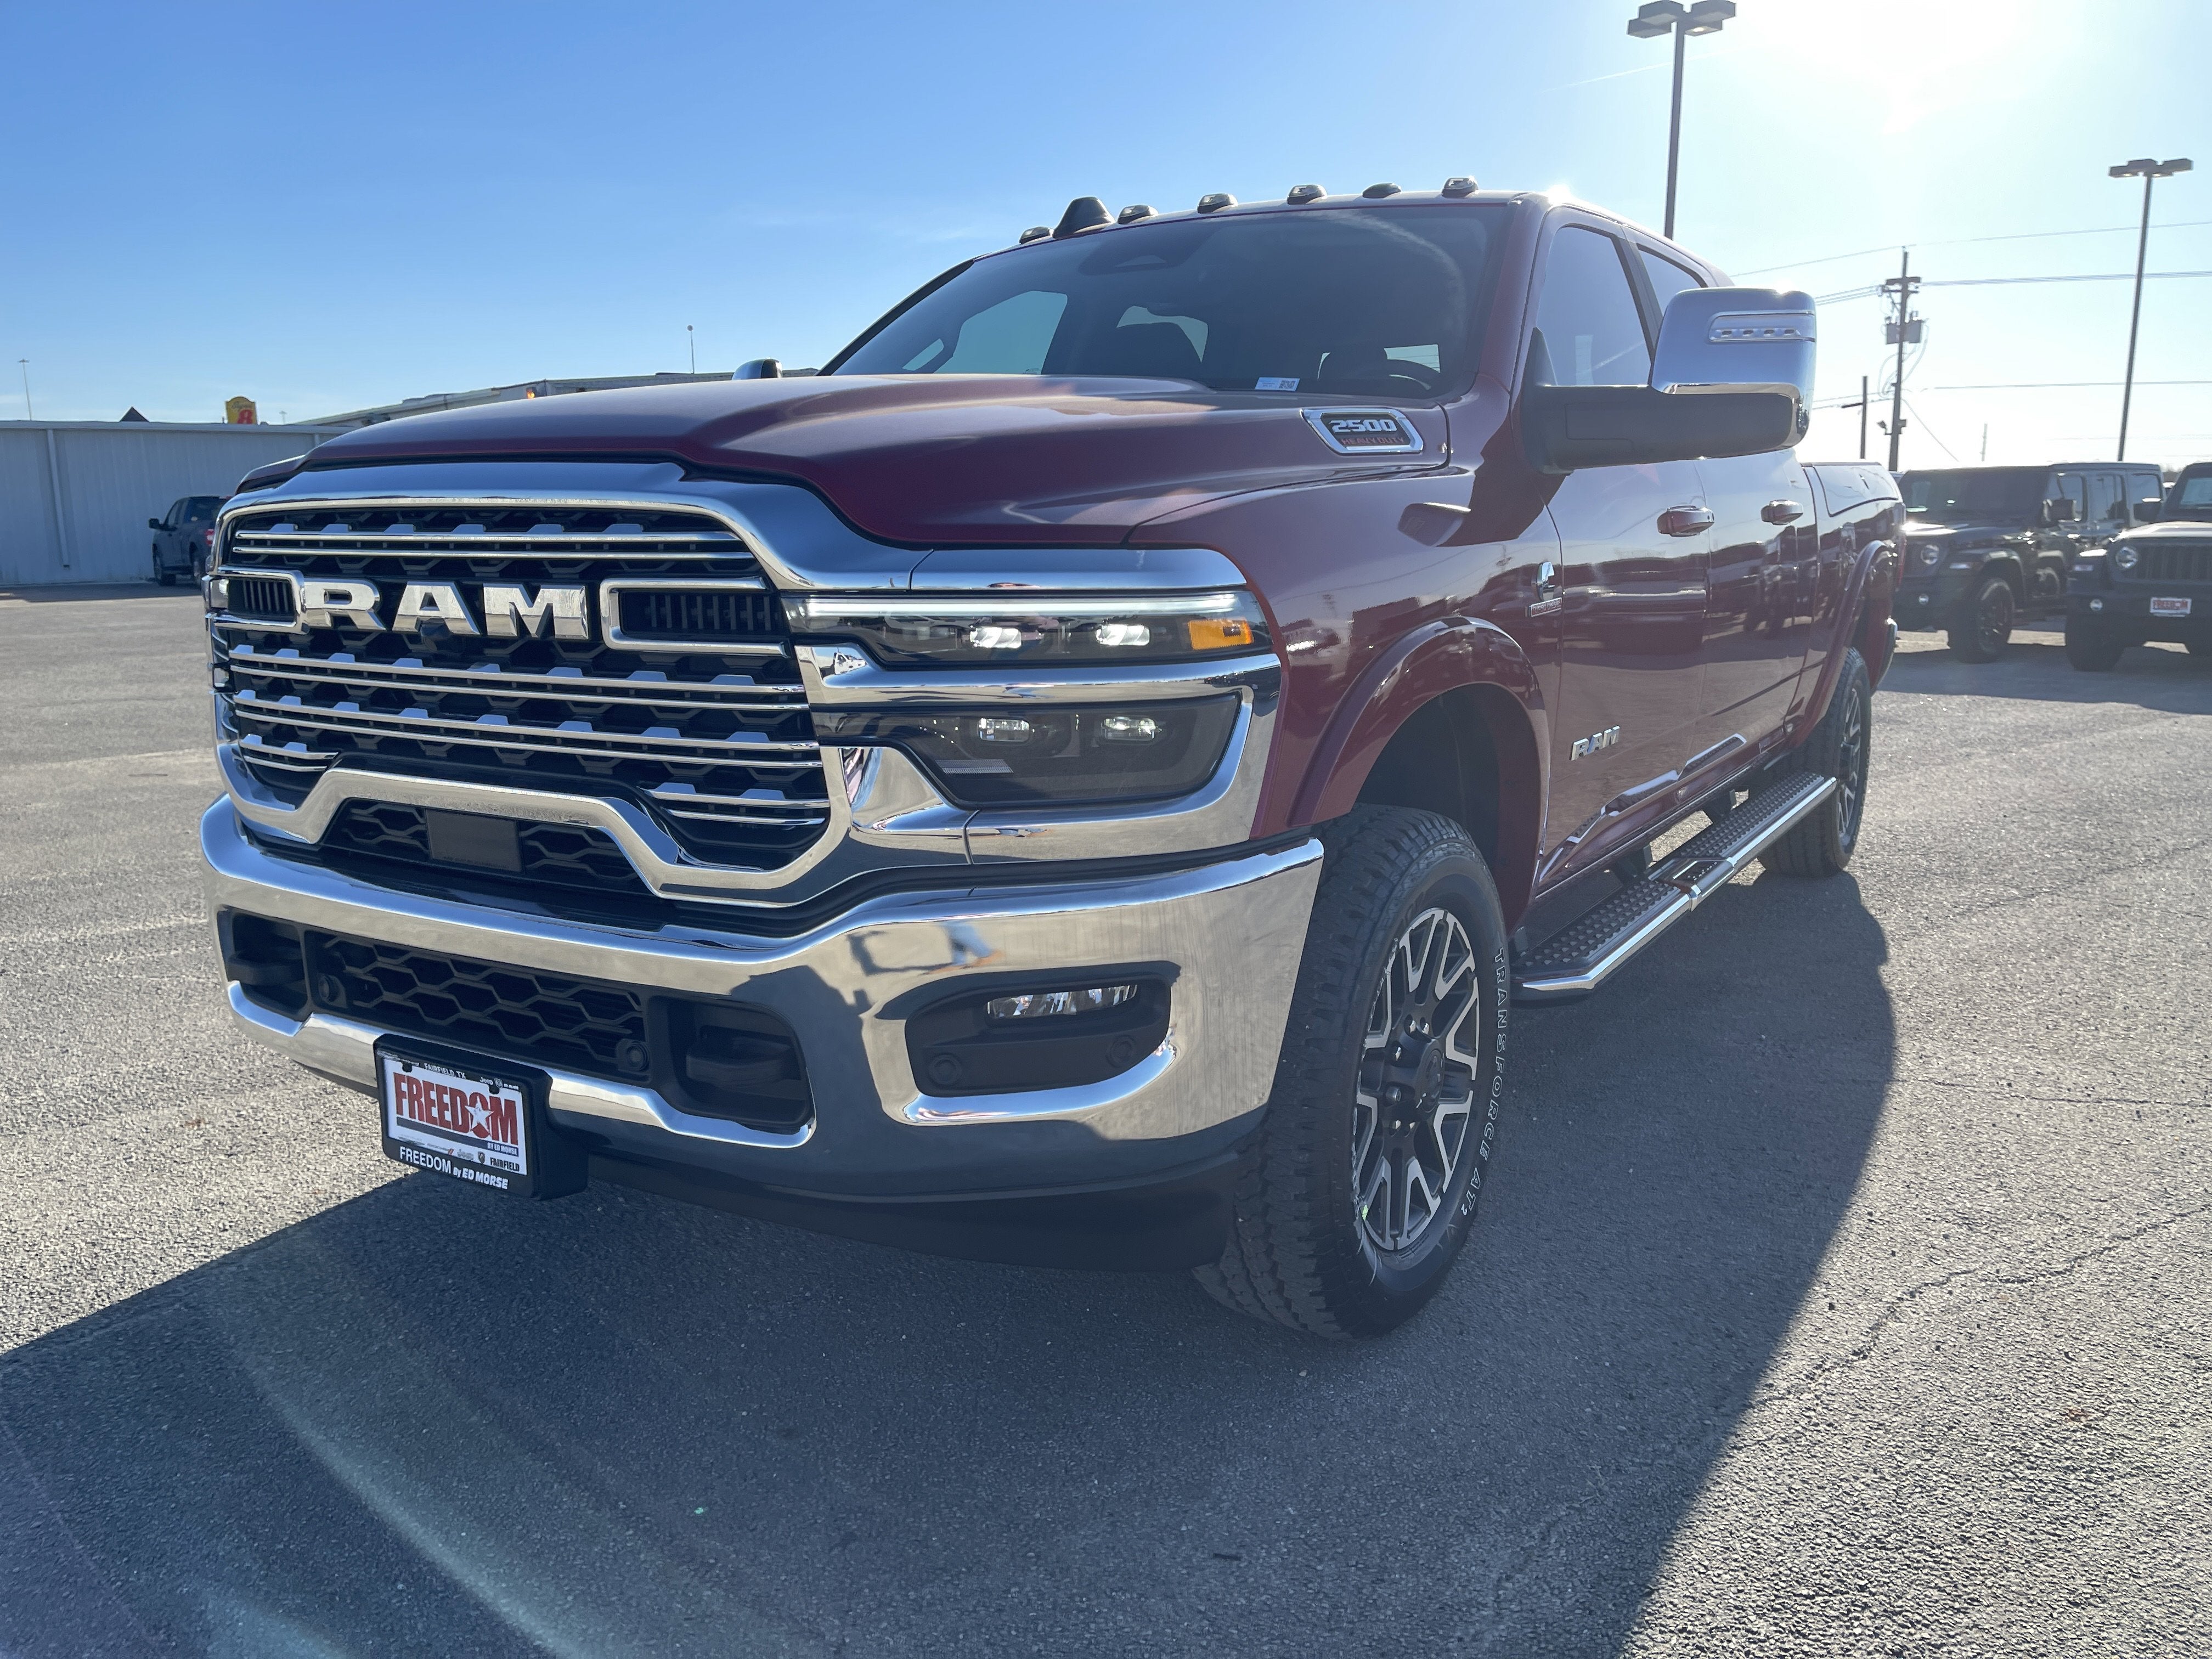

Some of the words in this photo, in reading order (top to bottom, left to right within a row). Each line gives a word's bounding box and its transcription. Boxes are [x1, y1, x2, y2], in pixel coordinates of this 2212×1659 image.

[1330, 419, 1397, 432] 2500
[303, 578, 589, 640] RAM
[1570, 725, 1620, 761] RAM
[1479, 947, 1508, 1160] TRANSFORCE
[393, 1072, 518, 1145] FREEDOM
[399, 1146, 452, 1174] FREEDOM
[462, 1167, 475, 1180] ED
[475, 1171, 509, 1190] MORSE
[490, 1157, 520, 1172] FAIRFIELD
[494, 1143, 500, 1152] ED
[500, 1145, 518, 1155] MORSE
